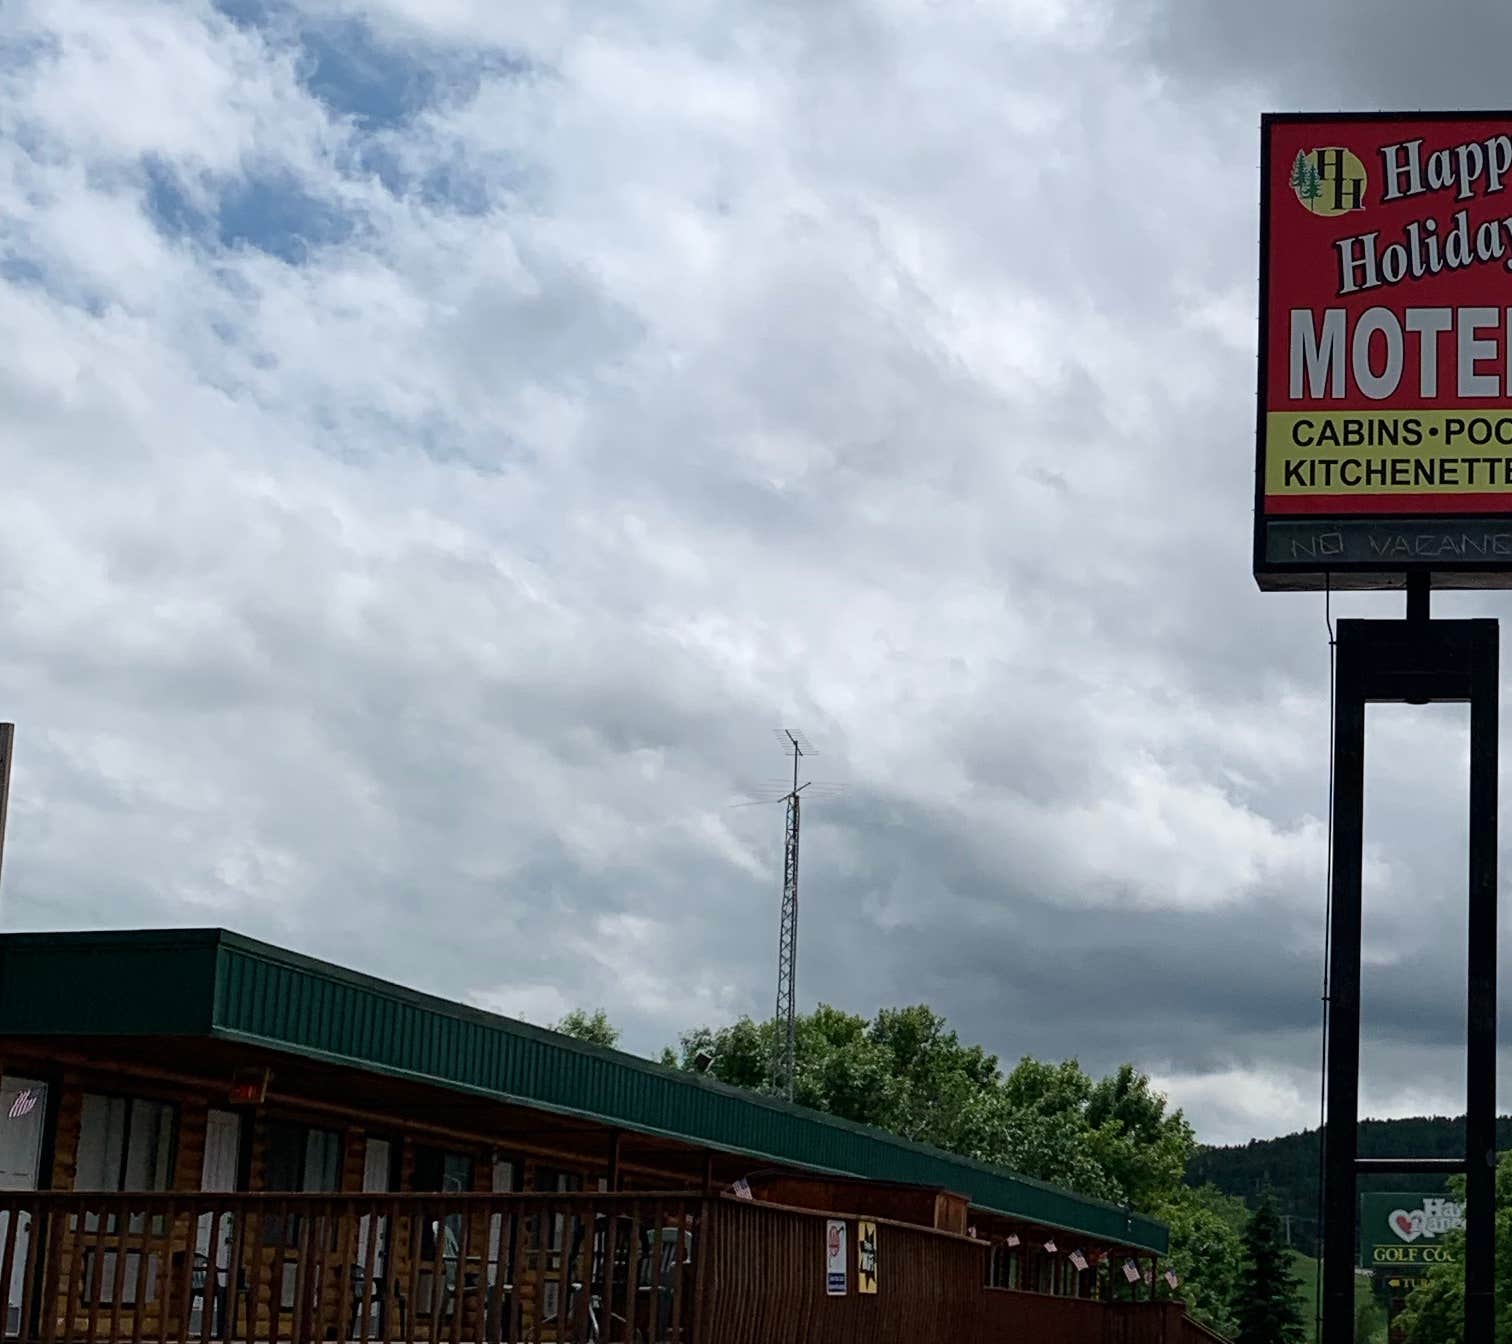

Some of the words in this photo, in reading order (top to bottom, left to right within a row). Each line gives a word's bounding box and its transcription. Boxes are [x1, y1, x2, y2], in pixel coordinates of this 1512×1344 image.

[1291, 418, 1423, 447] CABINS
[1291, 532, 1344, 557] NO
[1373, 1247, 1418, 1262] GOLF
